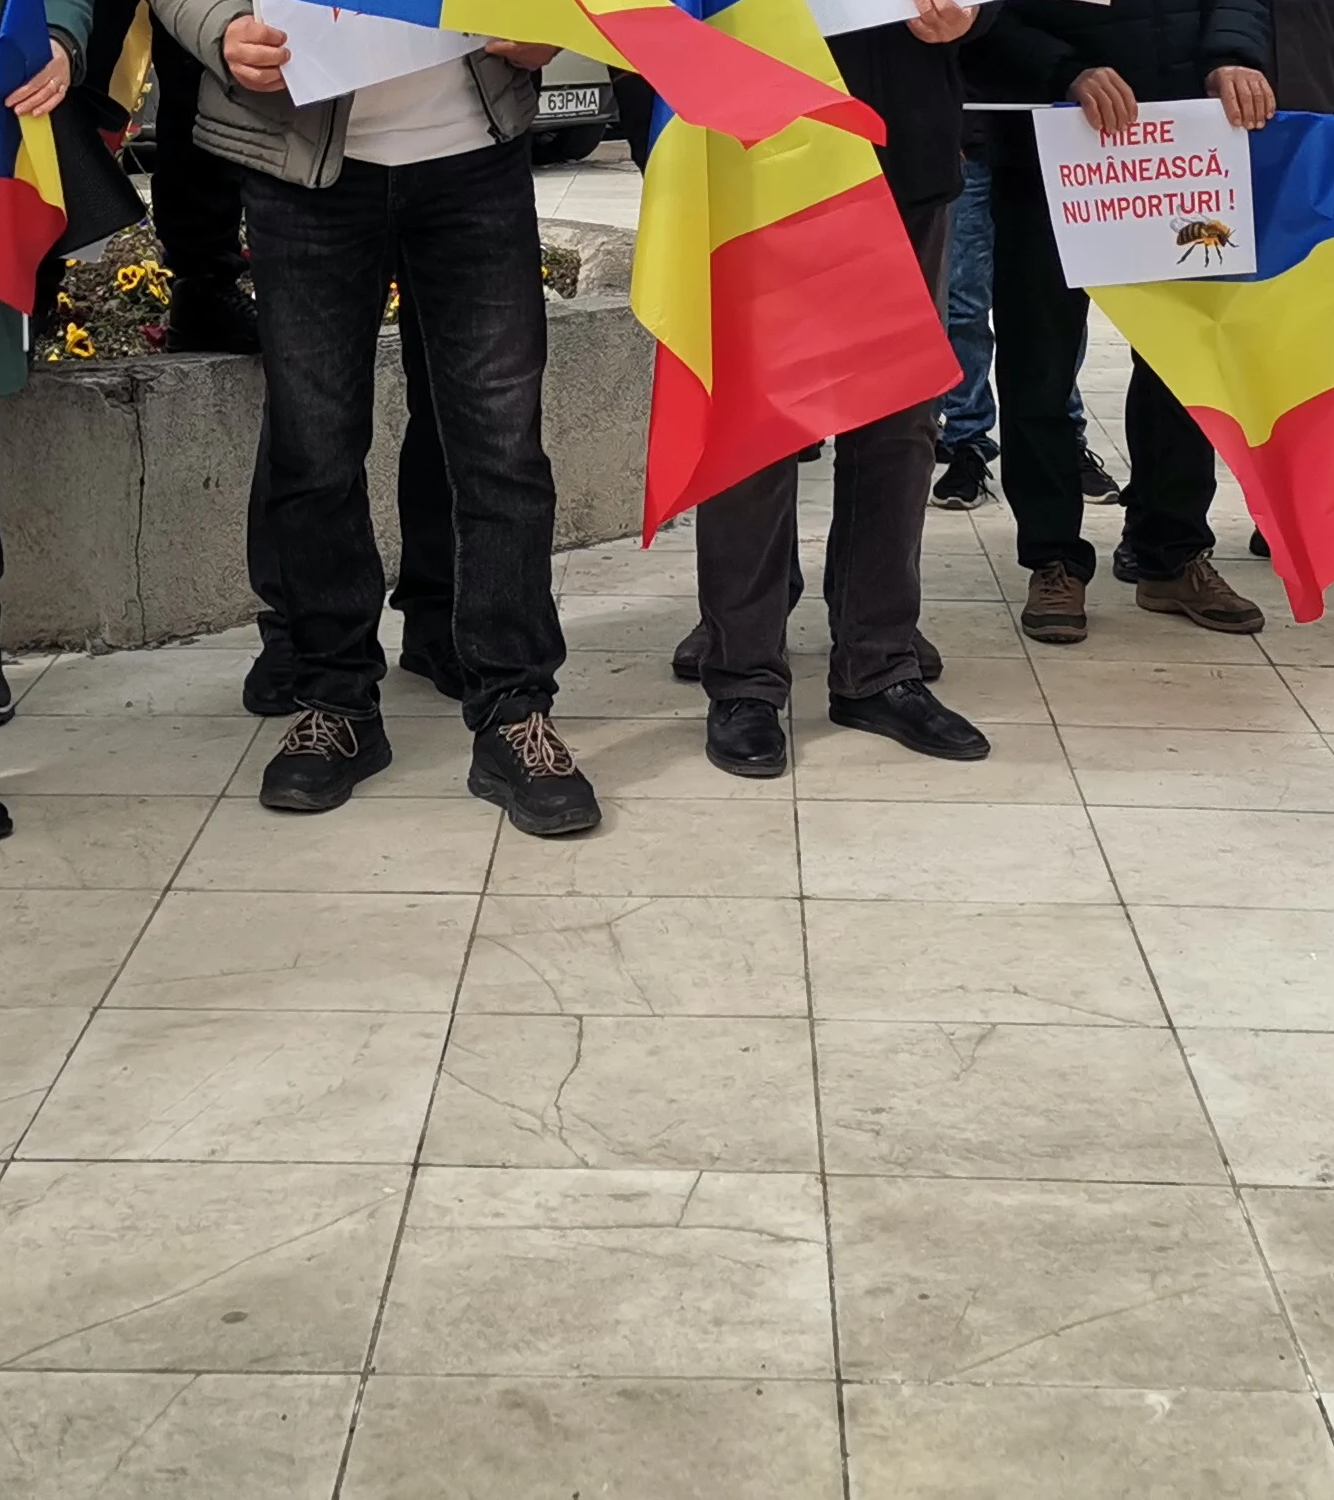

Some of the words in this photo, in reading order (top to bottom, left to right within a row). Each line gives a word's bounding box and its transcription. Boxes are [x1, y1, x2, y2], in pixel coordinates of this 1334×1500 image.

[1059, 148, 1229, 188] ROMÂNEASCĂ,
[1062, 200, 1091, 225] NU
[1095, 189, 1221, 222] IMPORTURI
